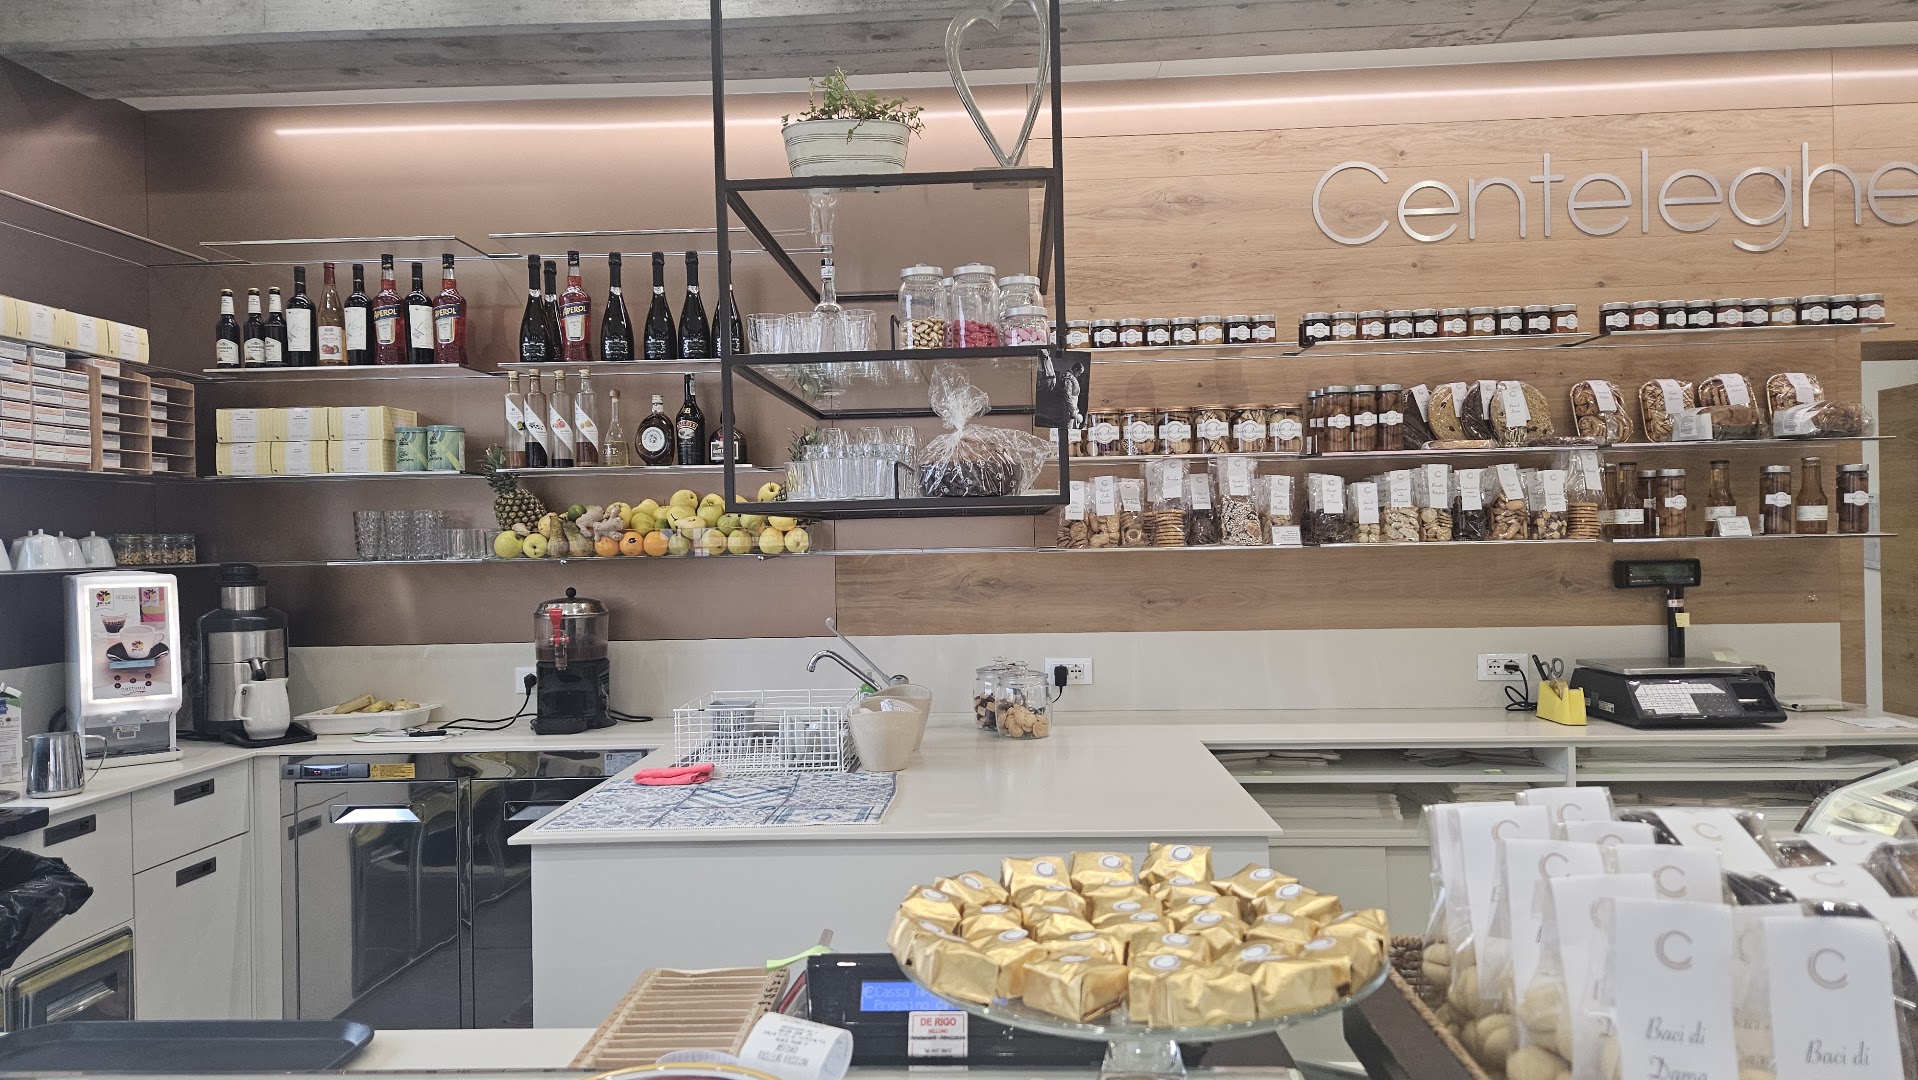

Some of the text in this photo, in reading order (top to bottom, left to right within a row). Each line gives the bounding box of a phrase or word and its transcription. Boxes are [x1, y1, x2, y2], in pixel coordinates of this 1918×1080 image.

[1312, 141, 1918, 252] Centeleghe
[373, 308, 398, 320] APEROL
[435, 307, 457, 318] APEROL
[563, 305, 587, 317] APEROL
[1653, 865, 1688, 898] C
[1655, 929, 1693, 971] C
[1807, 948, 1848, 990] C
[920, 1017, 957, 1026] DE RIGO
[1645, 1015, 1685, 1041] Baci
[1688, 1018, 1707, 1044] di
[1805, 1039, 1871, 1066] Baci di
